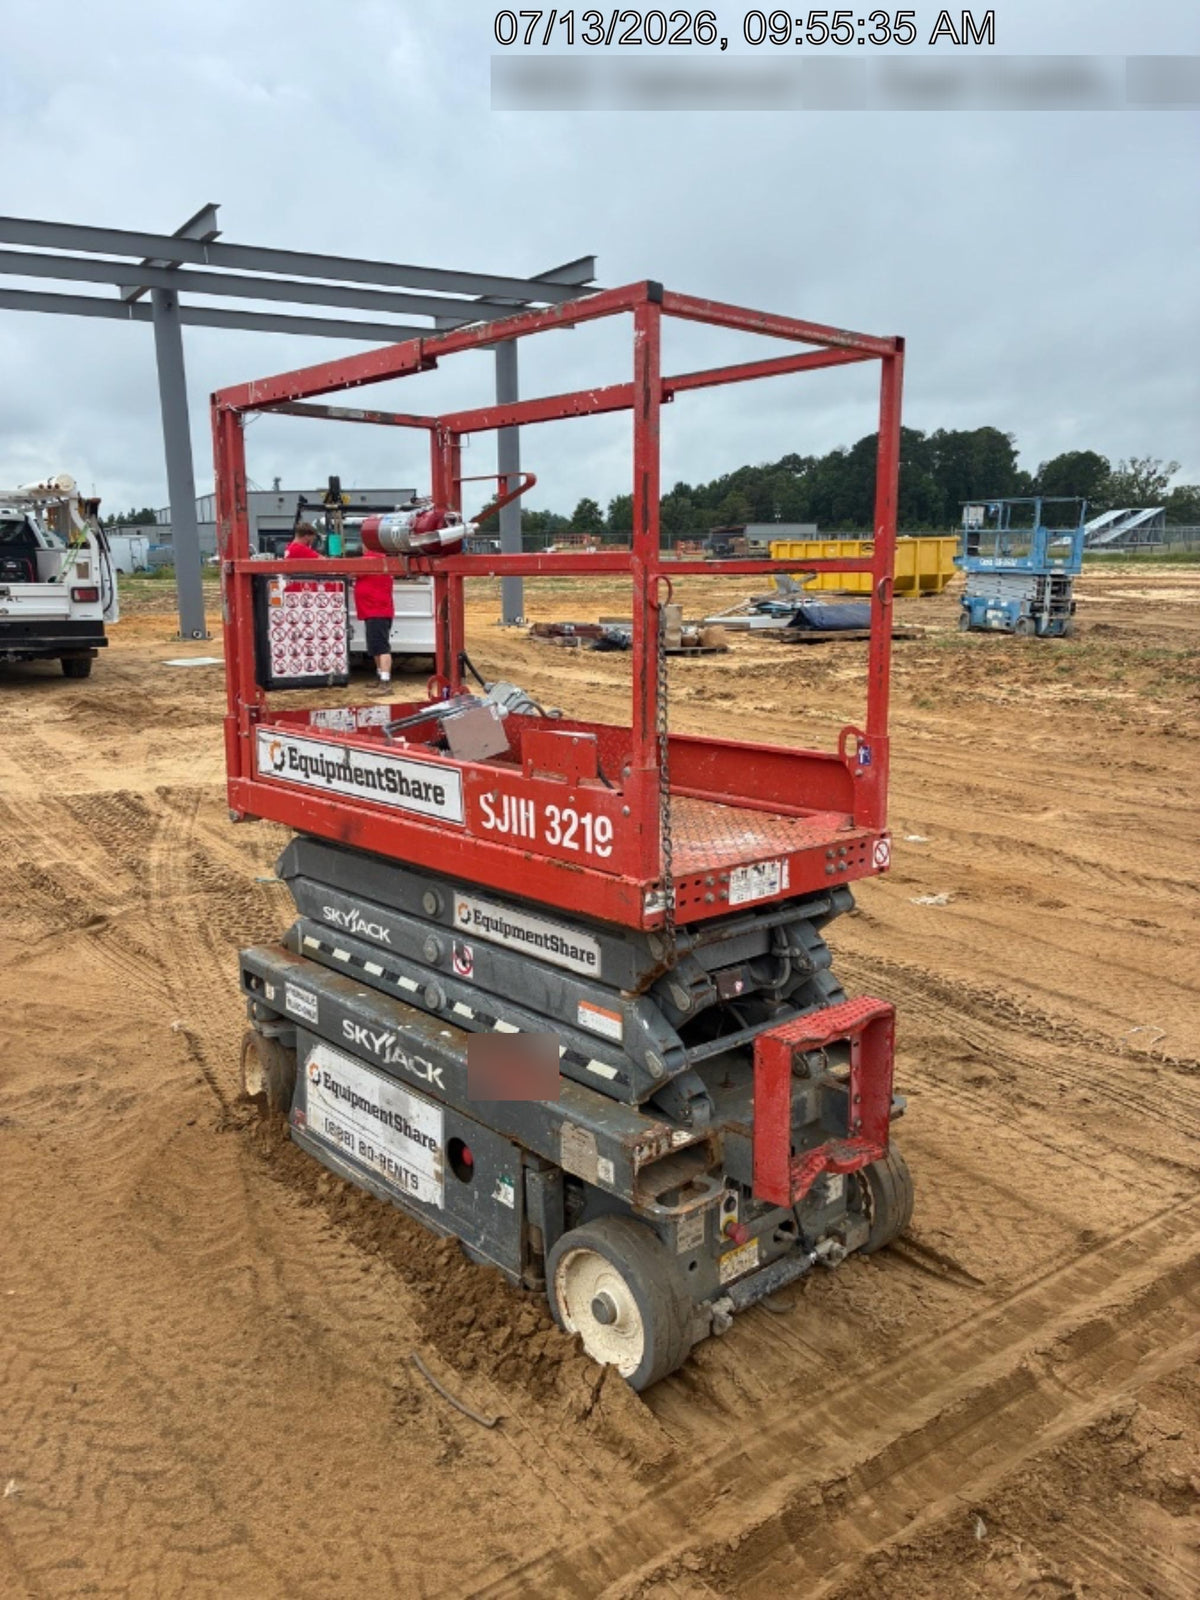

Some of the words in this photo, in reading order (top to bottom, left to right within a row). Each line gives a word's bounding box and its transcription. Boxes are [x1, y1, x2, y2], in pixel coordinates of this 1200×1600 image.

[287, 746, 446, 806] EquipmentShare
[545, 804, 614, 858] 3219
[322, 906, 392, 945] SKYJACK
[472, 908, 597, 966] EquipmentShare
[342, 1019, 446, 1090] SKYJACK
[323, 1071, 438, 1153] EquipmentShare
